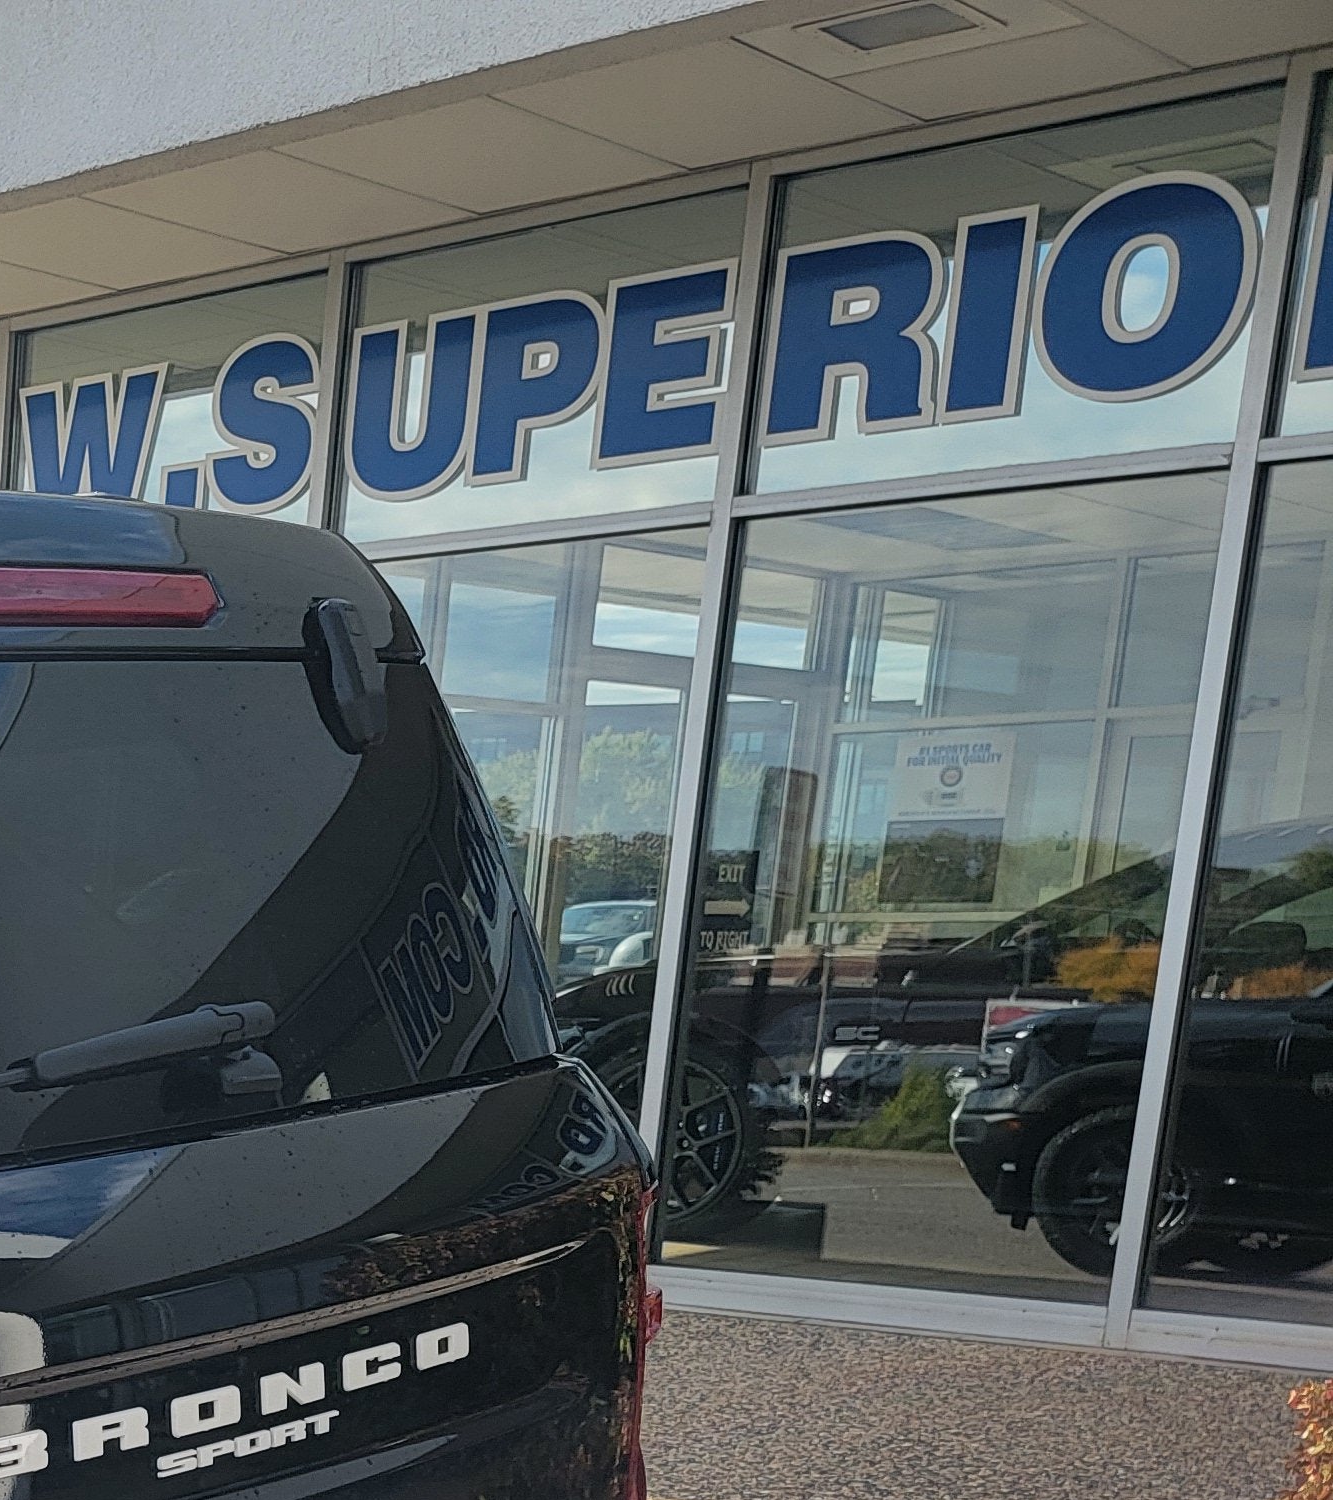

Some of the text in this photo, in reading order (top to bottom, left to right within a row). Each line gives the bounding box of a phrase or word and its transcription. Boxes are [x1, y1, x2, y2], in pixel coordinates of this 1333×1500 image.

[717, 863, 747, 883] EXIT
[699, 931, 750, 951] TO RIGHT
[156, 1409, 340, 1479] SPORT
